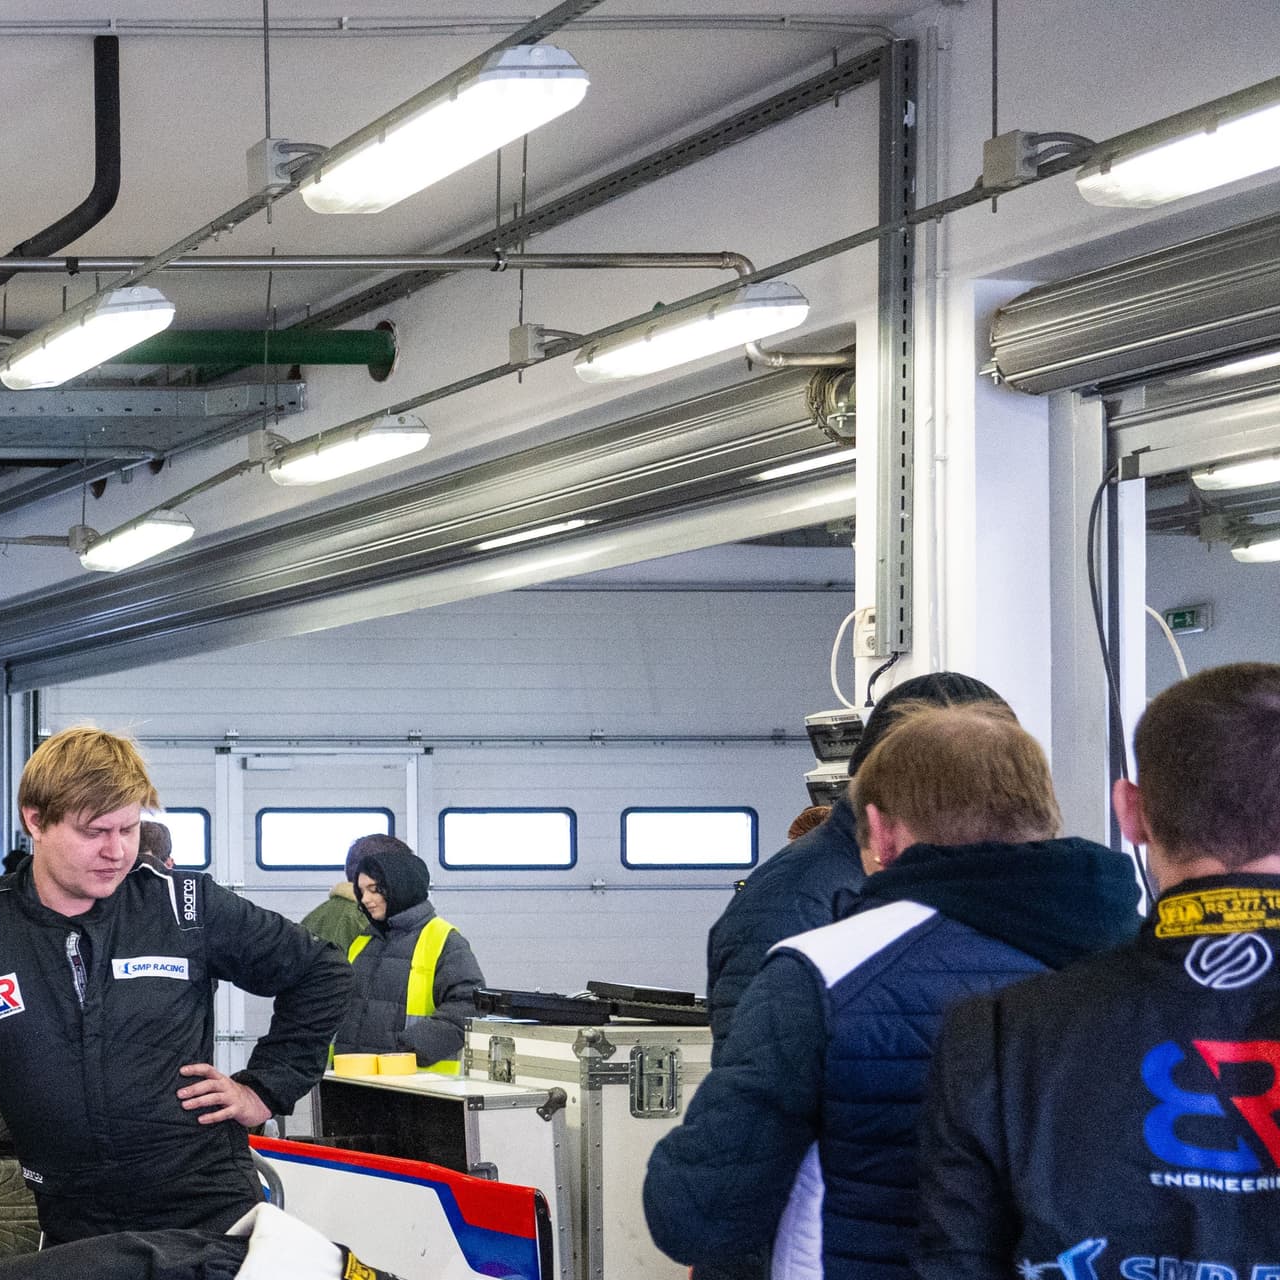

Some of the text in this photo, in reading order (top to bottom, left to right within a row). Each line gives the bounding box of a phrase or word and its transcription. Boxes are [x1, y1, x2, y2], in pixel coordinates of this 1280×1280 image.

[183, 879, 196, 921] sparco
[131, 963, 185, 974] SMP RACING
[1148, 1172, 1280, 1193] ENGINEERI
